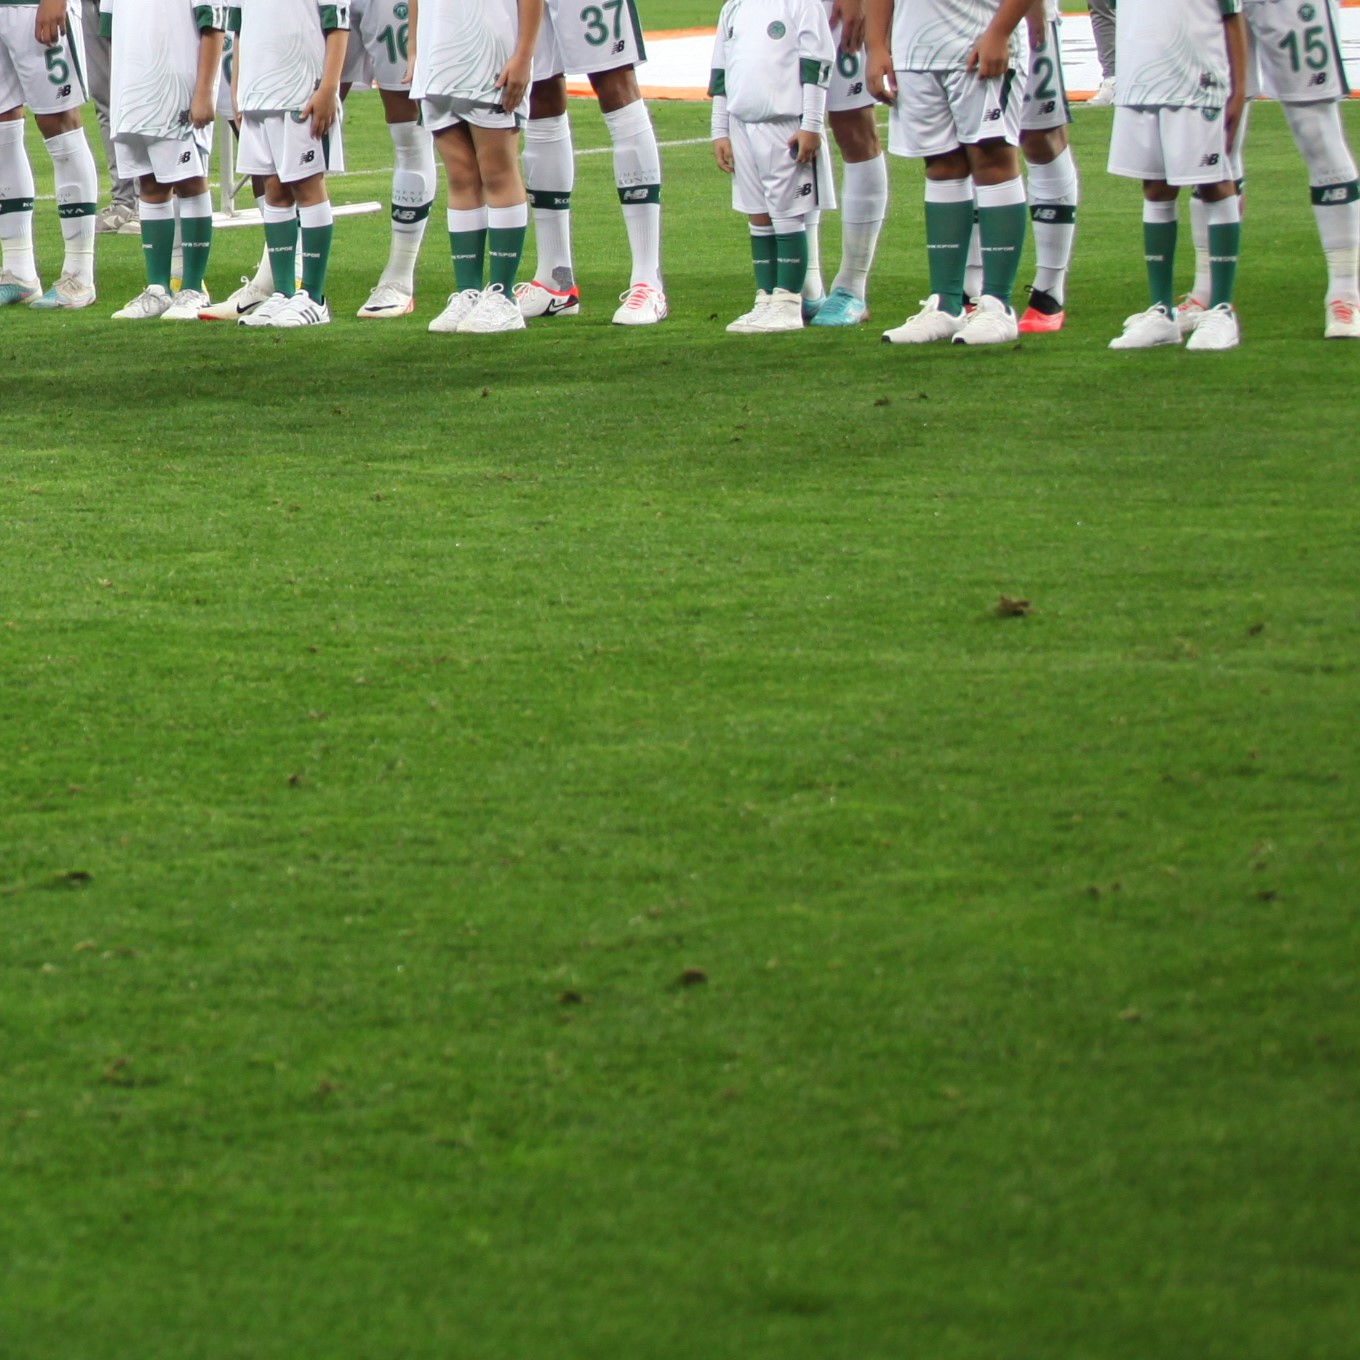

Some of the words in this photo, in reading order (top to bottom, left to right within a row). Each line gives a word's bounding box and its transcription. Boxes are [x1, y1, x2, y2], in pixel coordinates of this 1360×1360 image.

[377, 23, 410, 64] 16
[1280, 24, 1329, 73] 15
[43, 44, 69, 86] 5
